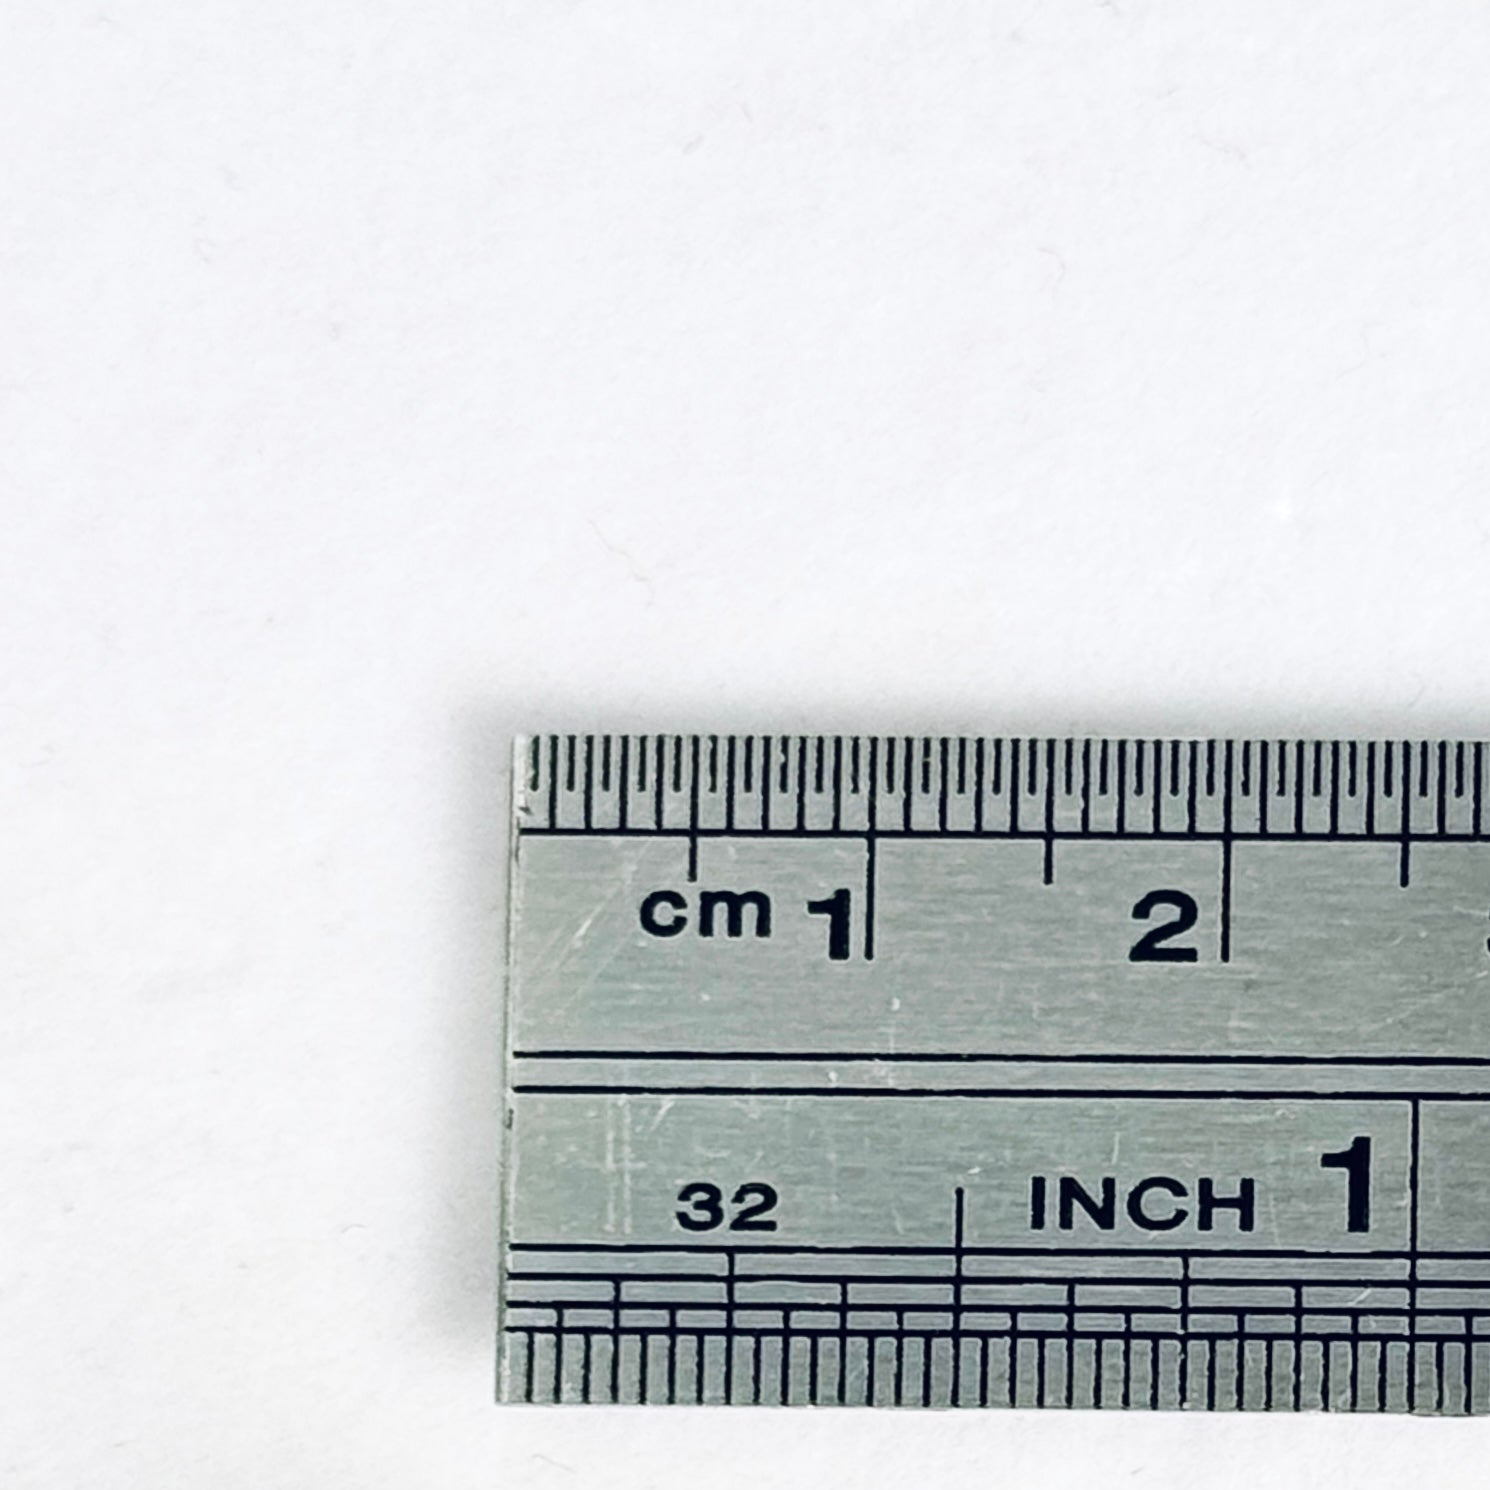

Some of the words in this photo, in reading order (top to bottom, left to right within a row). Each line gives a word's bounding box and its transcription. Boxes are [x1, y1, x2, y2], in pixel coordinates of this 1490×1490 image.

[638, 889, 771, 938] cm
[807, 888, 851, 961] 1
[1128, 889, 1199, 963] 2
[675, 1182, 778, 1232] 32
[1030, 1175, 1255, 1233] INCH
[1320, 1136, 1372, 1233] 1
